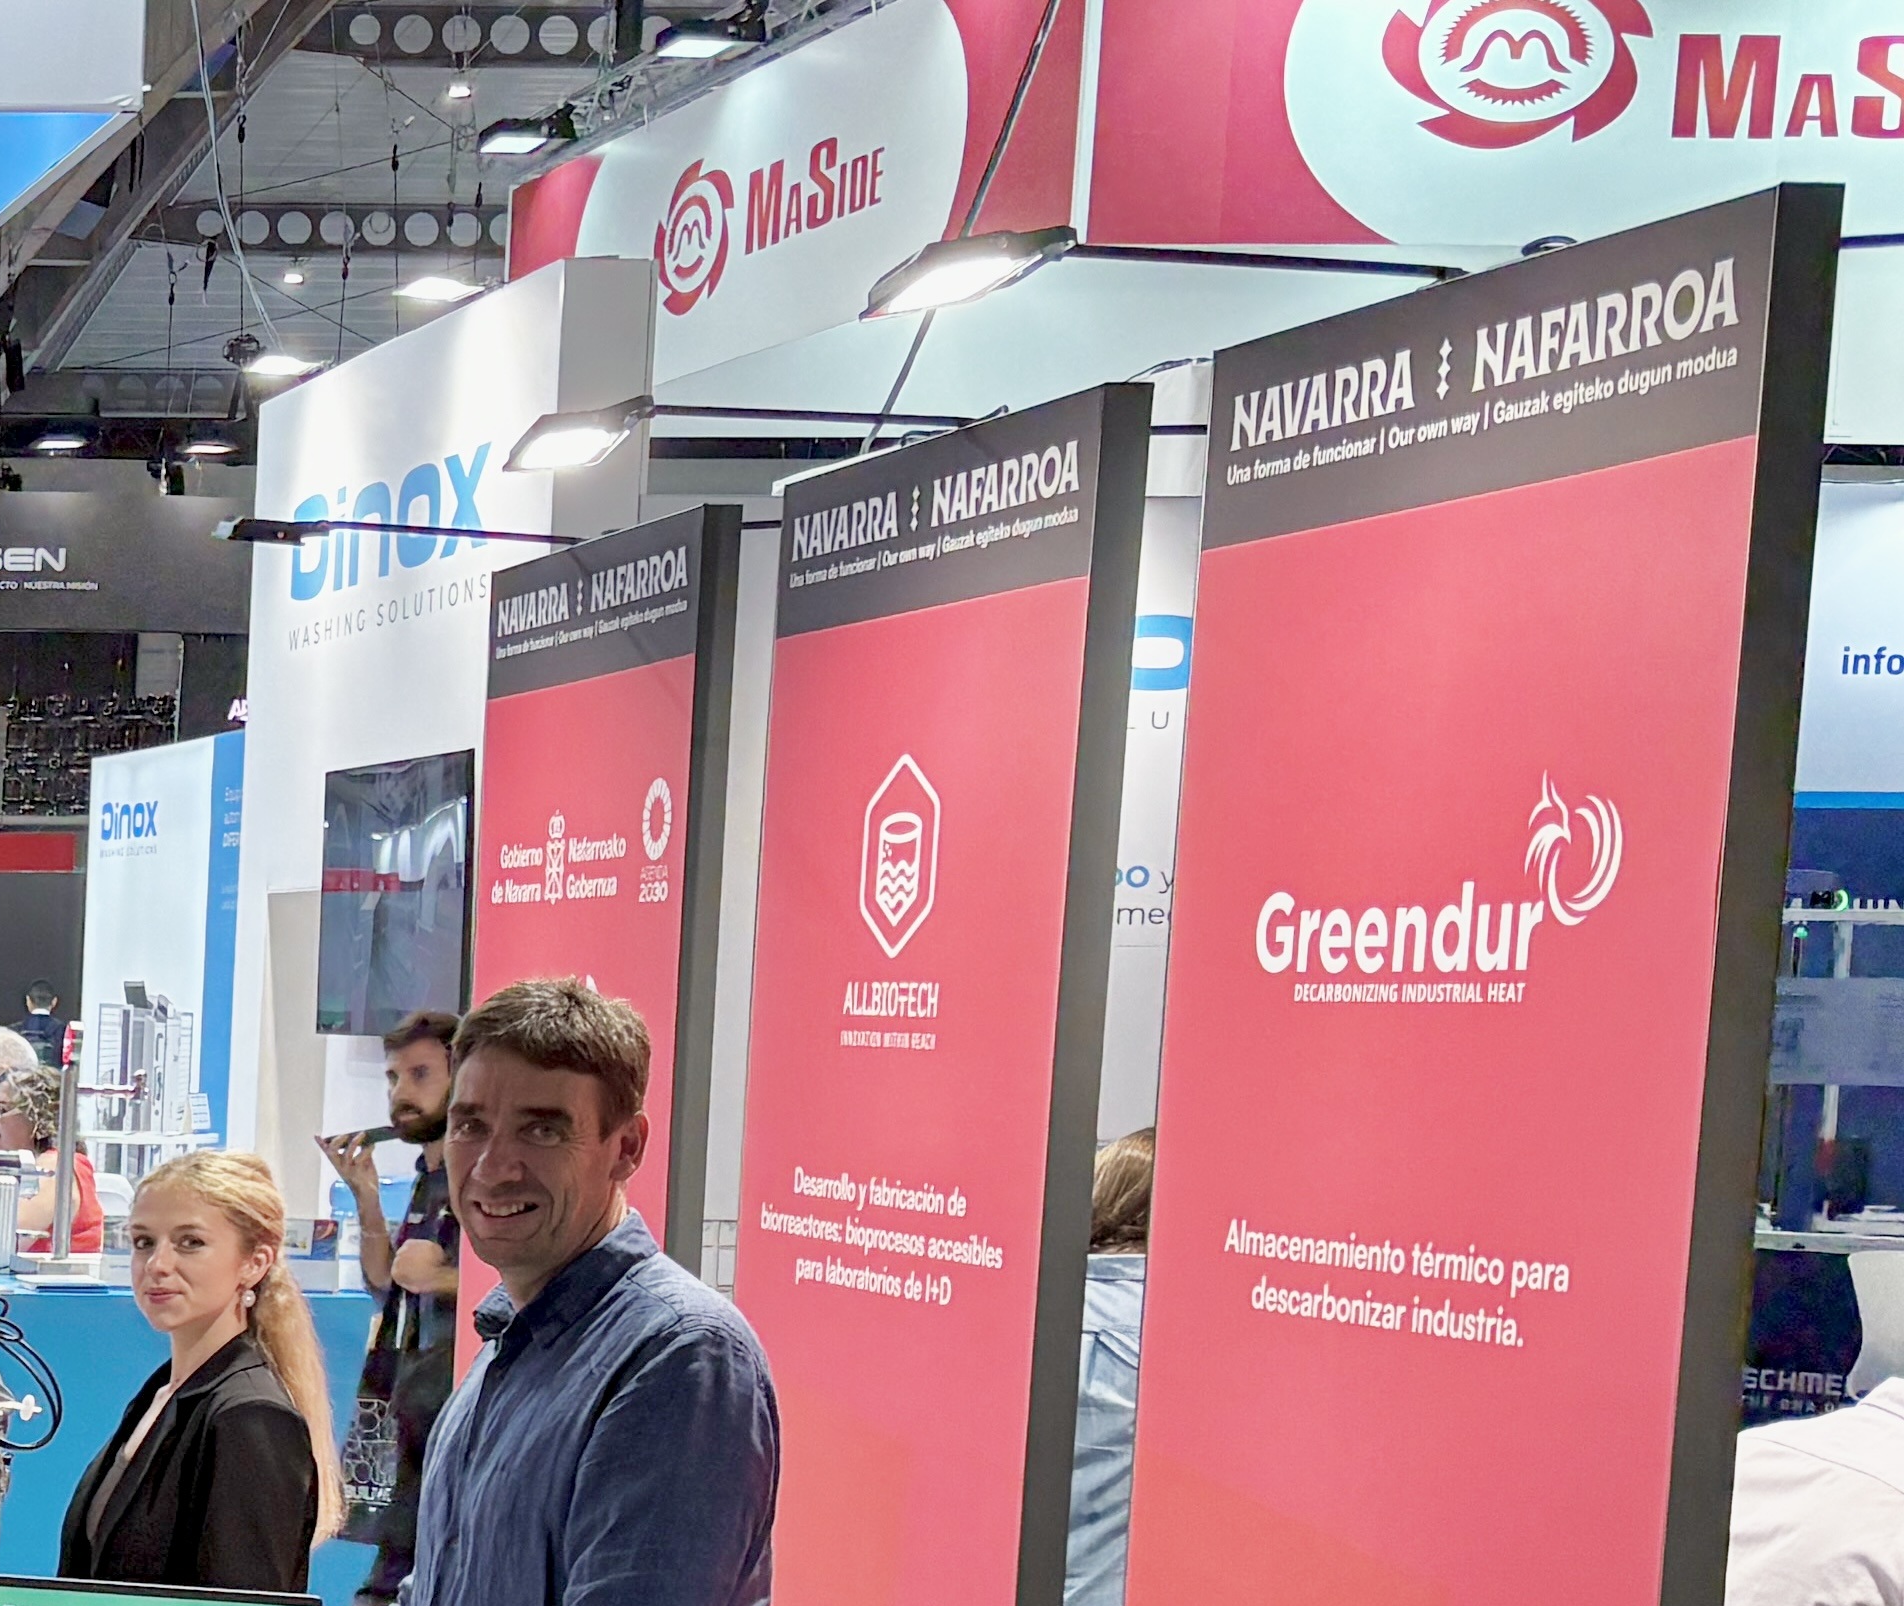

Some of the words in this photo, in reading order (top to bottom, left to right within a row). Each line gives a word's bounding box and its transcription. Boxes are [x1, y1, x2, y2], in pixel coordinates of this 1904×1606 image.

[1230, 349, 1415, 452] NAVARRA
[1471, 257, 1740, 393] NAFARROA
[1226, 463, 1250, 486] Una
[1253, 456, 1291, 479] forma
[1293, 449, 1311, 471] de
[1312, 435, 1376, 466] funcionar
[1388, 426, 1415, 449] Our
[1417, 419, 1447, 443] own
[1451, 412, 1480, 436] way
[1493, 390, 1549, 425] Gauzak
[1553, 375, 1614, 414] egiteko
[1618, 361, 1672, 396] dugun
[1676, 345, 1738, 380] modua
[792, 491, 899, 562] NAVARRA
[930, 440, 1080, 528] NAFARROA
[289, 609, 366, 651] WASHING
[376, 573, 488, 627] SOLUTIONS
[497, 583, 570, 638] NAVARRA
[590, 546, 688, 613] NAFARROA
[491, 879, 503, 904] de
[638, 880, 669, 903] 2030
[1255, 880, 1545, 974] Greendur
[843, 981, 940, 1018] ALLBIOTECH
[1294, 982, 1398, 1003] DECARBONIZING
[1402, 982, 1483, 1003] INDUSTRIAL
[1487, 982, 1526, 1003] HEAT
[793, 1165, 856, 1202] Desarrollo
[856, 1182, 867, 1211] y
[868, 1176, 944, 1215] fabricación
[946, 1186, 967, 1218] de
[760, 1202, 843, 1243] biorreactores:
[845, 1215, 925, 1258] bioprocesos
[928, 1233, 1003, 1270] accesibles
[1224, 1218, 1405, 1274] Almacenamiento
[1411, 1241, 1505, 1286] térmico
[1509, 1259, 1570, 1298] para
[795, 1257, 823, 1285] para
[825, 1255, 901, 1299] laboratorios
[904, 1270, 922, 1302] de
[1251, 1275, 1406, 1331] descarbonizar
[1411, 1295, 1524, 1348] industria.
